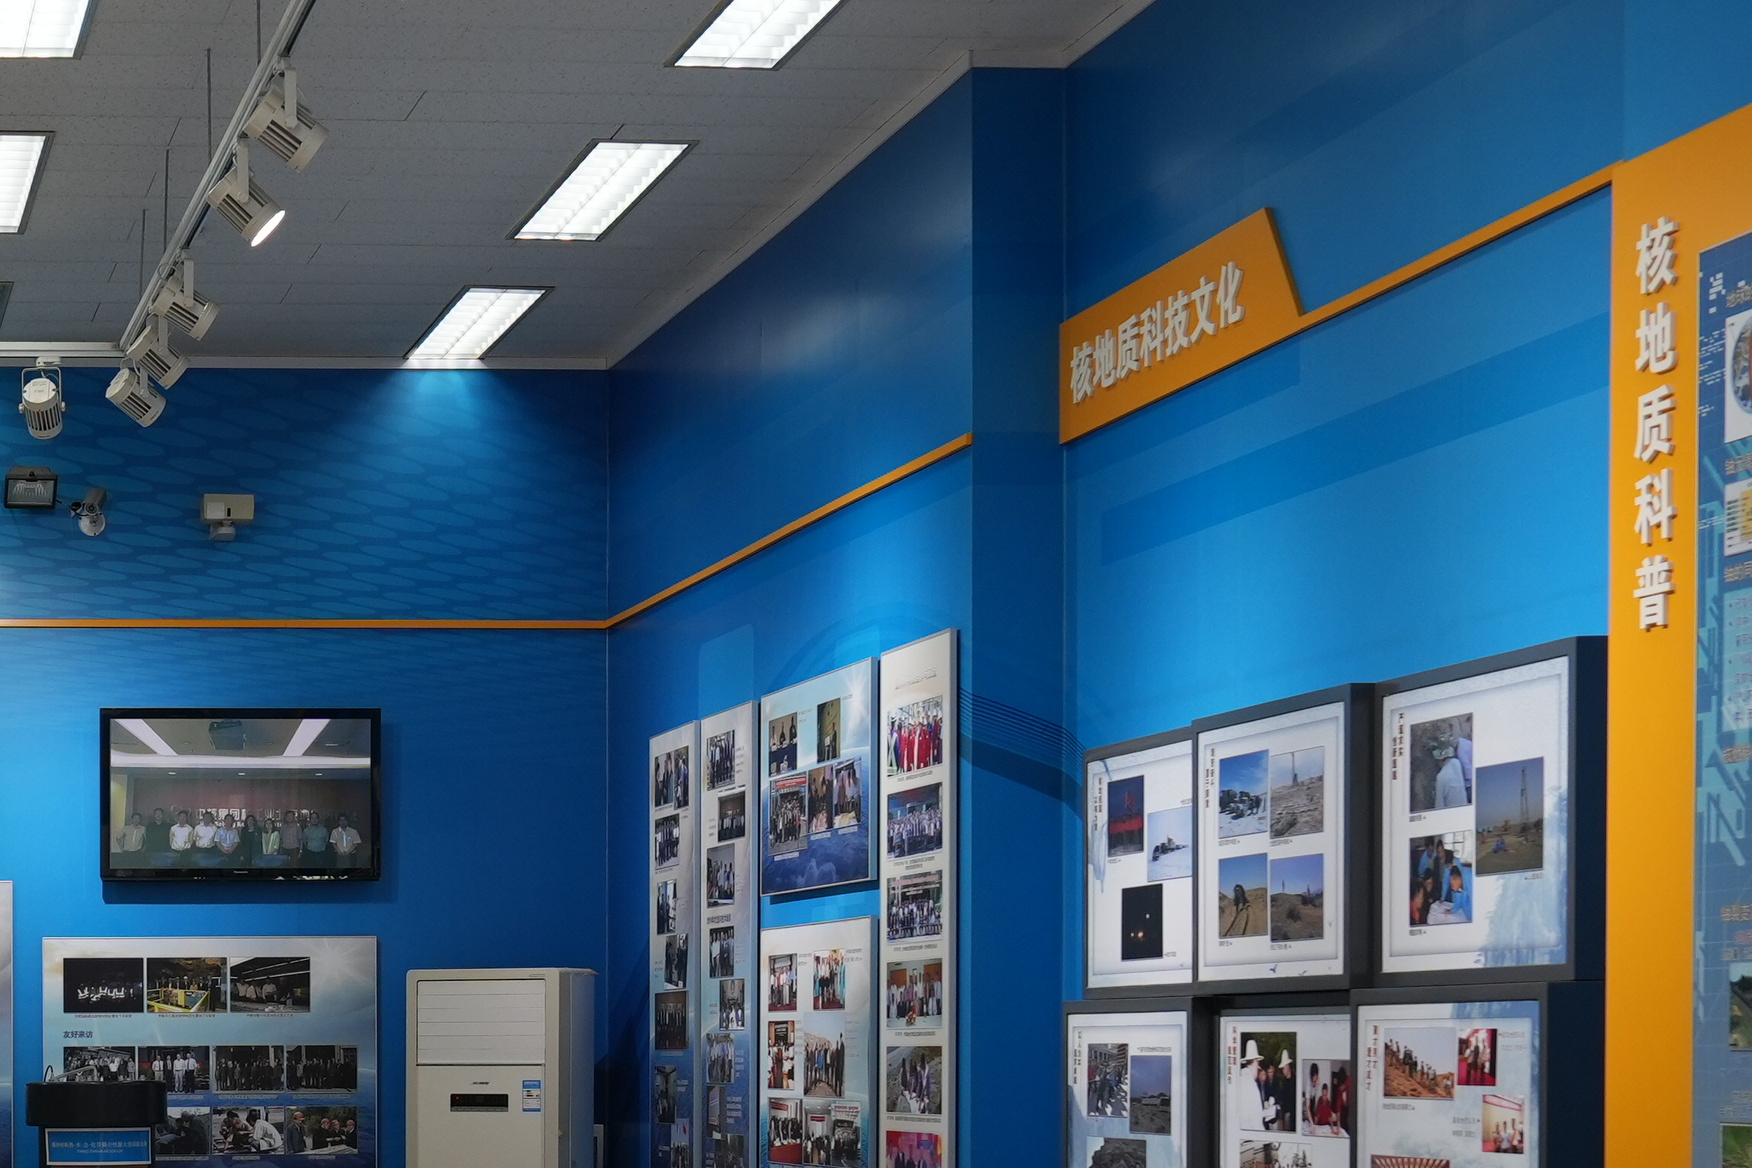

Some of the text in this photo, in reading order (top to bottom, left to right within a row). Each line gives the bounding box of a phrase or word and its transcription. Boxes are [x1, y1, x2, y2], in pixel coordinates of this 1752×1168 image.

[1069, 261, 1245, 404] 核地质科技文化
[1633, 216, 1679, 632] 核地质科普
[62, 1030, 93, 1039] 友好来访
